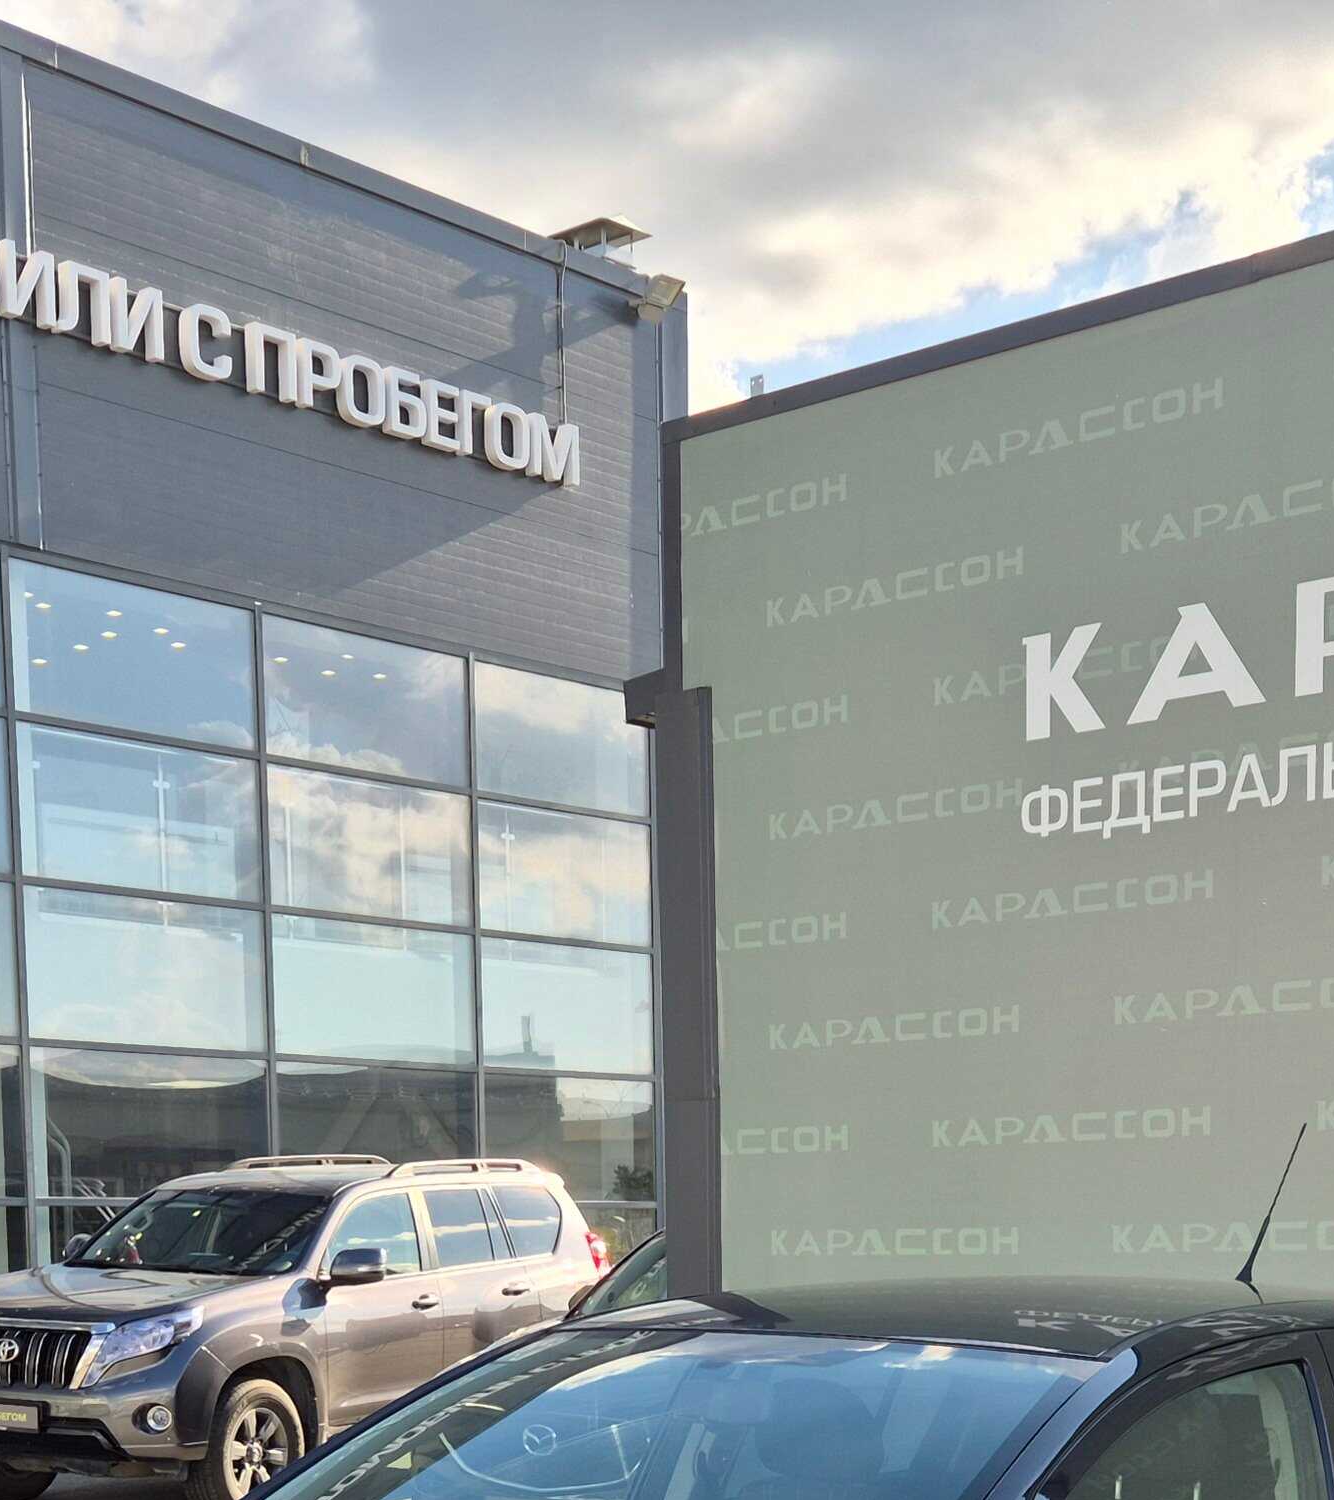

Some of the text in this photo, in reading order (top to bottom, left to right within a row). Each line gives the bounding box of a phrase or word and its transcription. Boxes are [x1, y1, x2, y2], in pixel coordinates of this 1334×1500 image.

[179, 303, 233, 381] С
[245, 320, 581, 487] ПРОБЕГОМ
[934, 378, 1224, 479] КАРАССОН
[767, 546, 1024, 628] КАРАССОН
[768, 778, 1023, 841] КАРАССОН
[931, 868, 1215, 930] КАРАССОН
[768, 1004, 1021, 1050] КАРАССОН
[931, 1106, 1212, 1149] КАРАССОН
[770, 1226, 1020, 1257] КАРАССОН
